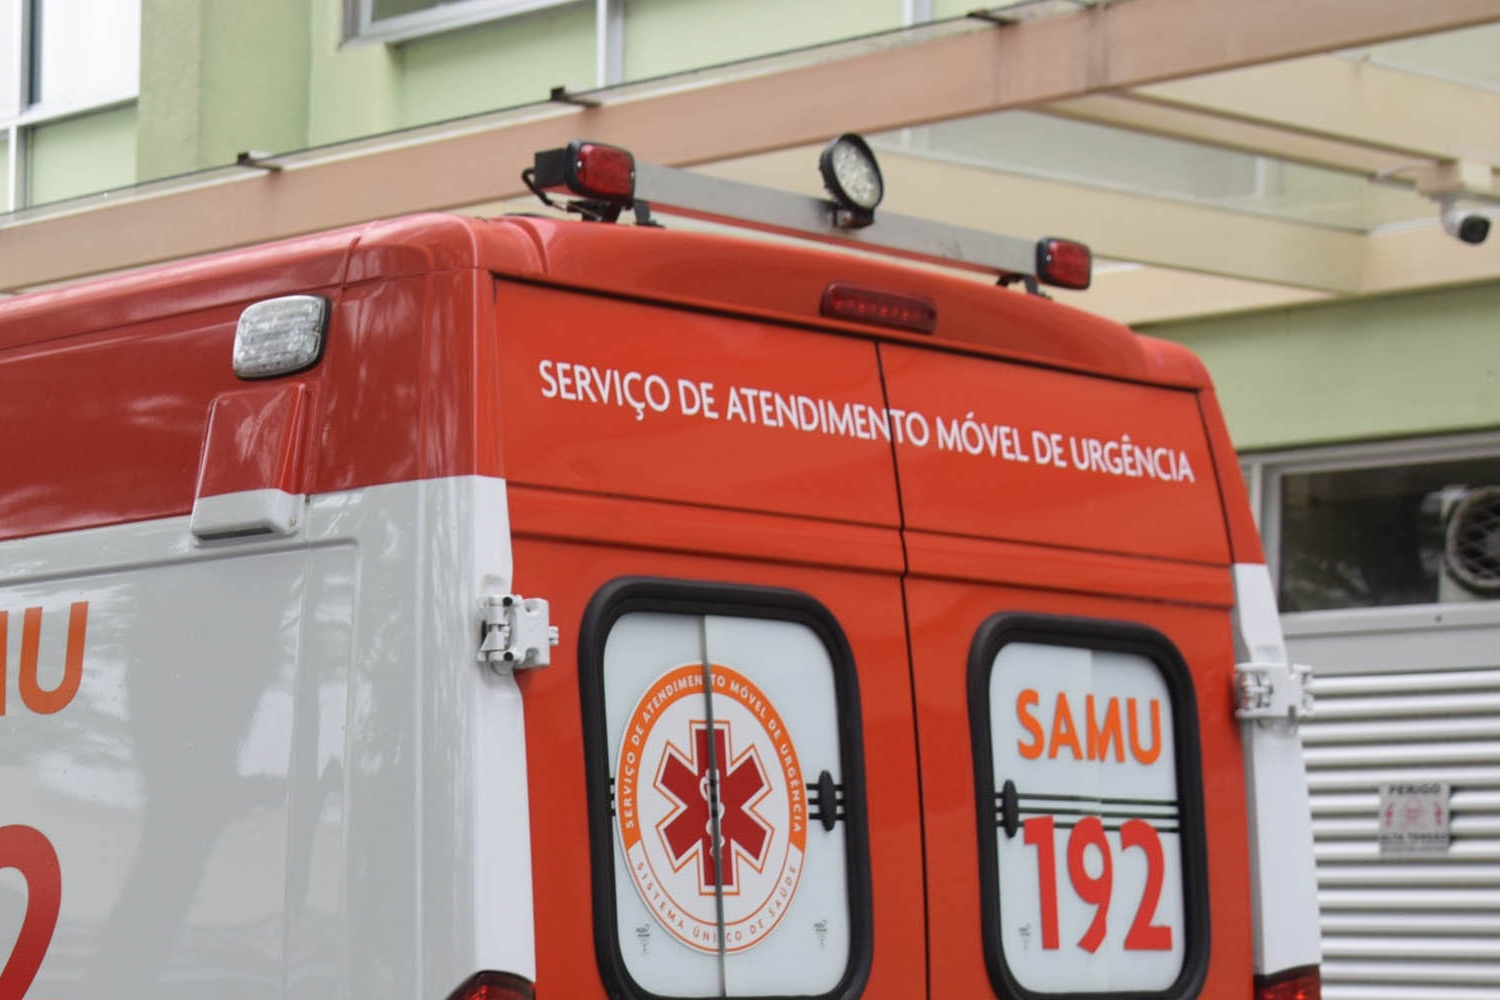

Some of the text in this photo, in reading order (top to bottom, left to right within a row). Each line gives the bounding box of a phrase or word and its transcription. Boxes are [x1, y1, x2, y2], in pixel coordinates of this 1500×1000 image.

[539, 360, 1196, 483] SERVIÇO DE ATENDIMENTO MÓVEL DE URGÊNCIA
[623, 752, 636, 829] SERVIÇO
[631, 724, 644, 746] DE
[1016, 689, 1162, 765] SAMU
[1023, 816, 1172, 954] 192
